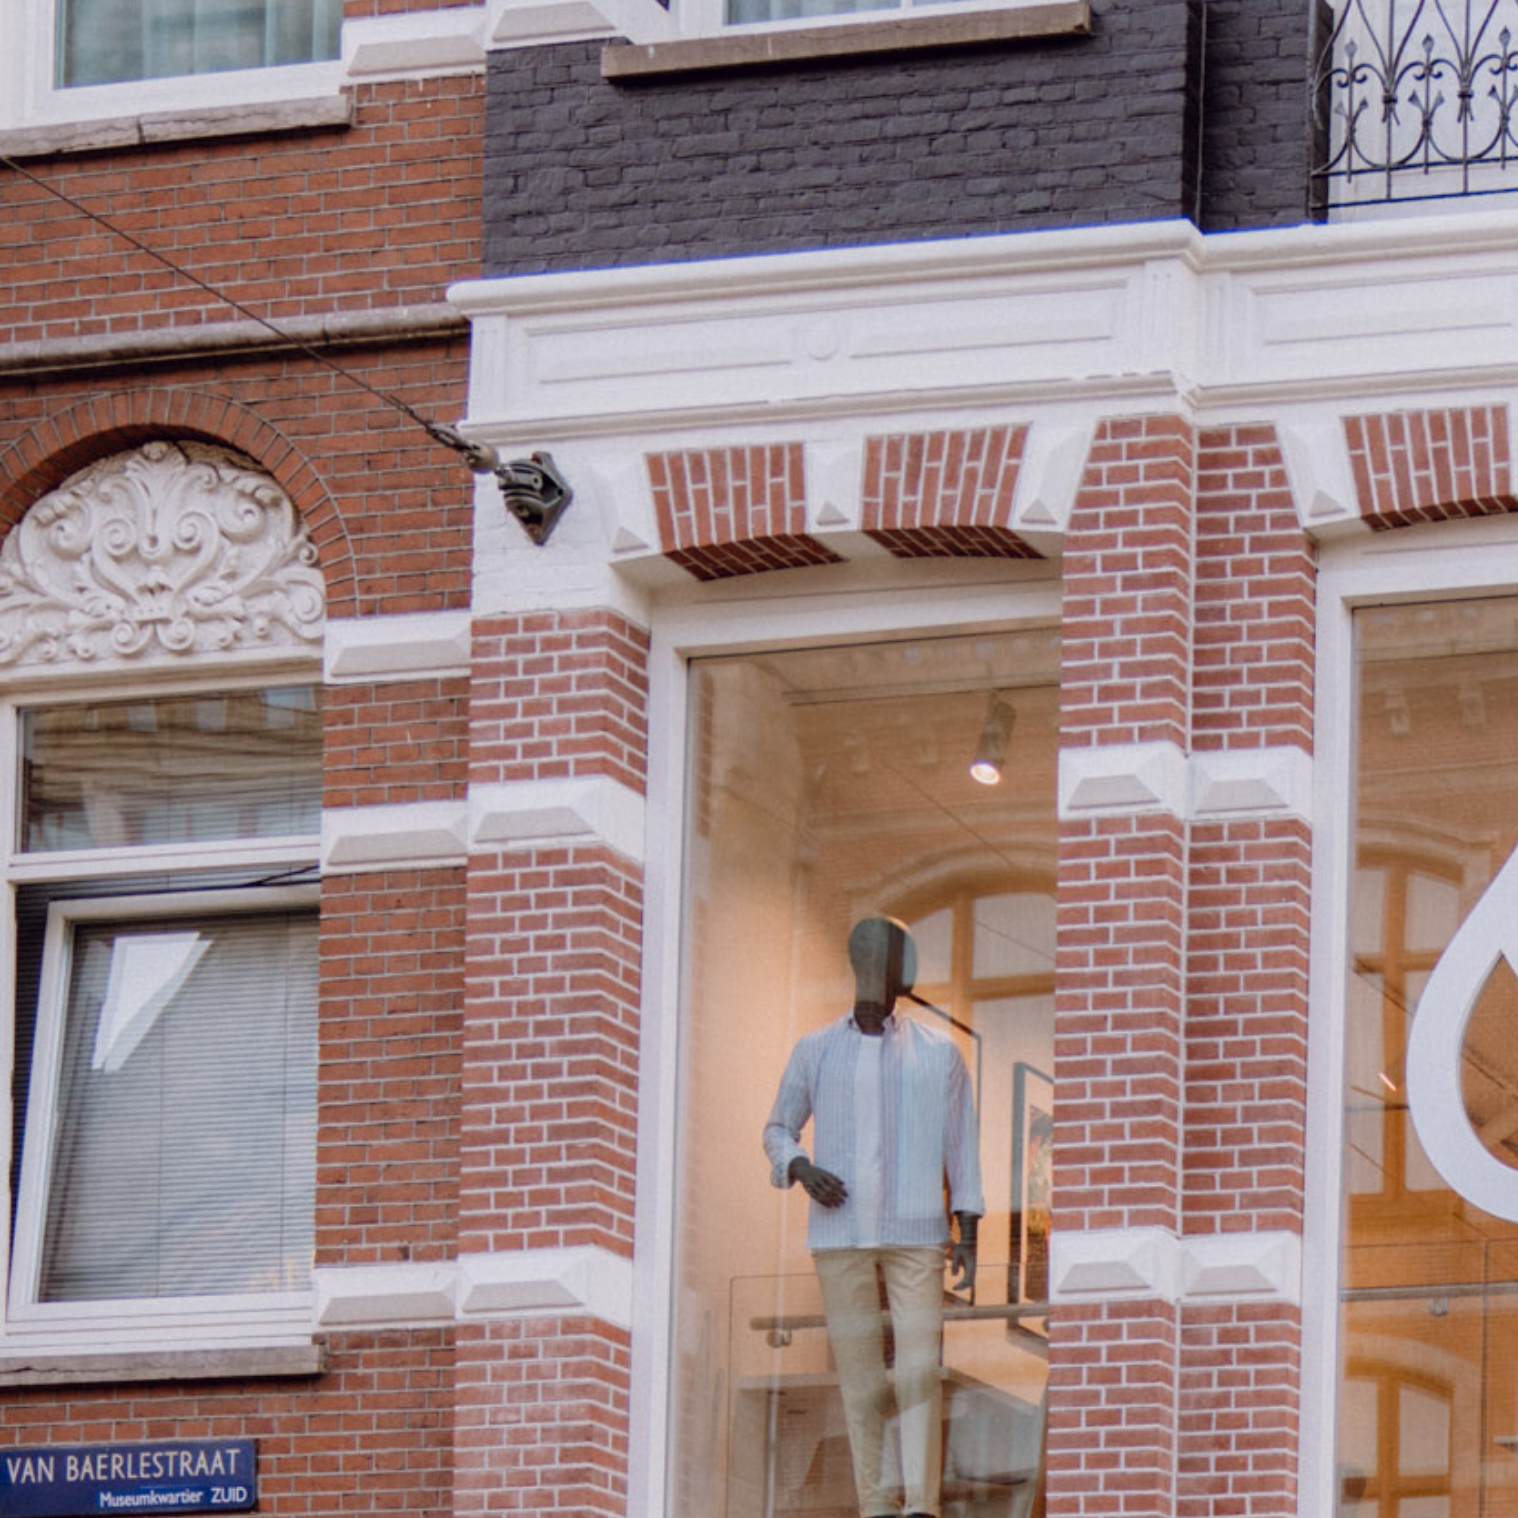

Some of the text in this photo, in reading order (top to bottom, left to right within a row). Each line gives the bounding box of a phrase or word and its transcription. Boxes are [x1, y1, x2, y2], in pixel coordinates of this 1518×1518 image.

[7, 1448, 241, 1484] VAN BAERLESTRAAT
[99, 1486, 248, 1507] Museumkwartier ZUID
